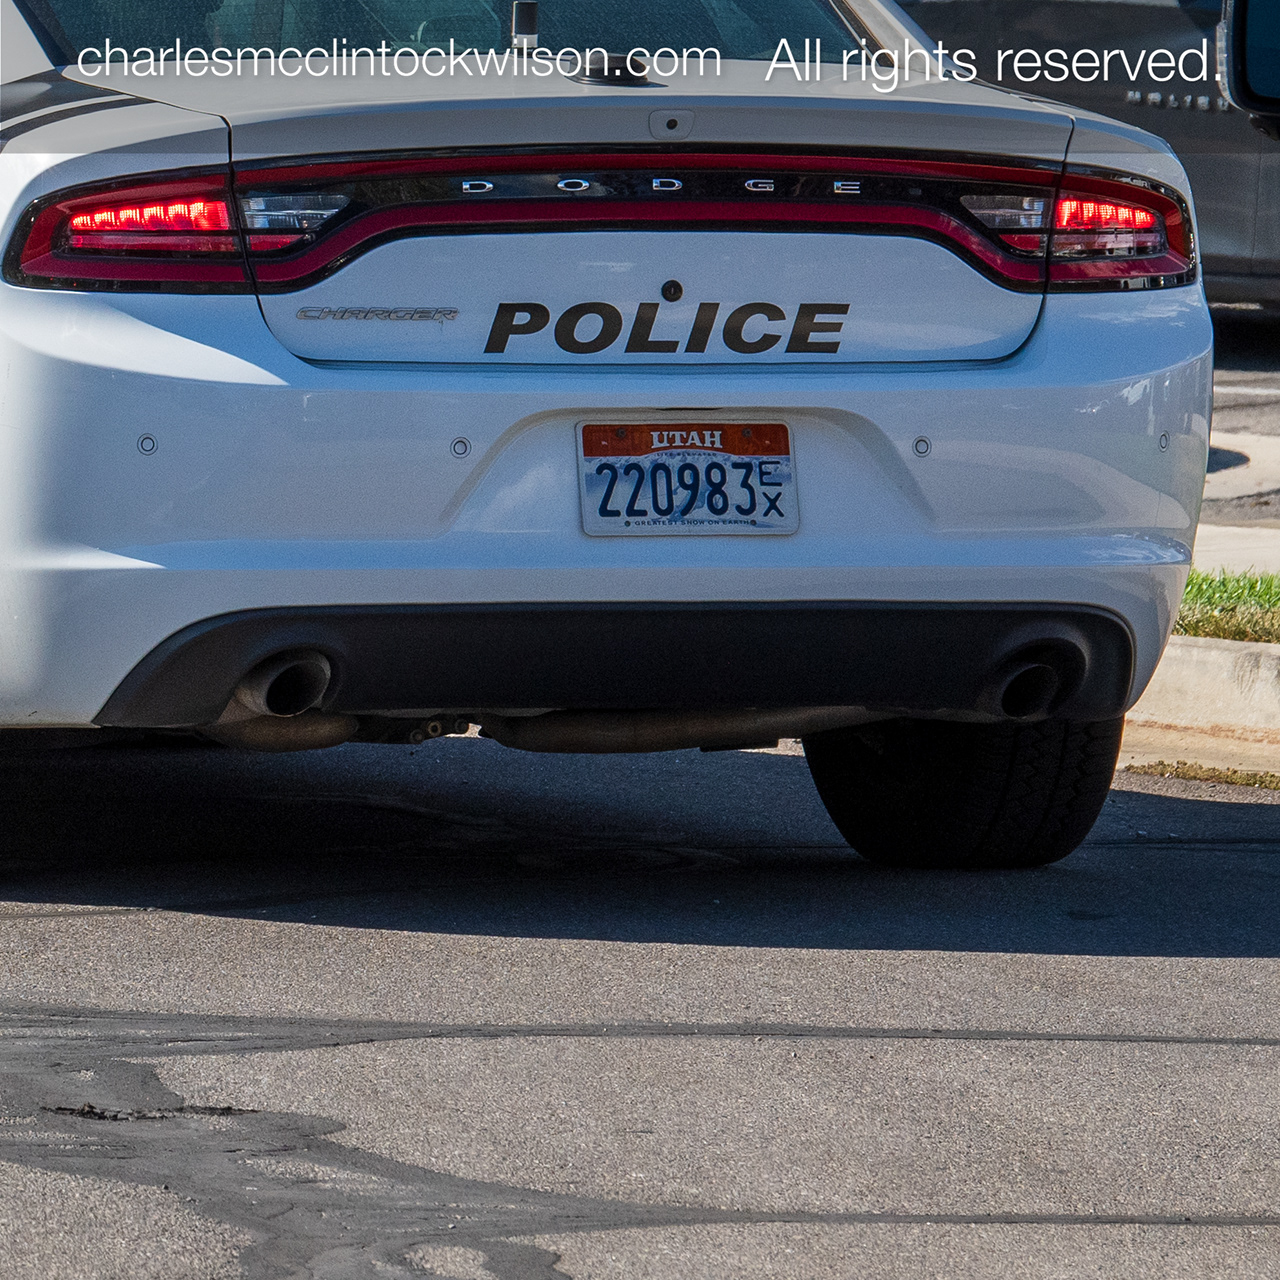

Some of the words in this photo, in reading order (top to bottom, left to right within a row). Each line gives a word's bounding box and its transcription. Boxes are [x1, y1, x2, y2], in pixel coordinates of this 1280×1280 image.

[462, 178, 861, 195] DODGE
[295, 306, 459, 321] CHARGER
[483, 302, 851, 355] POLICE
[650, 430, 723, 449] UTAH
[595, 462, 758, 518] 220983
